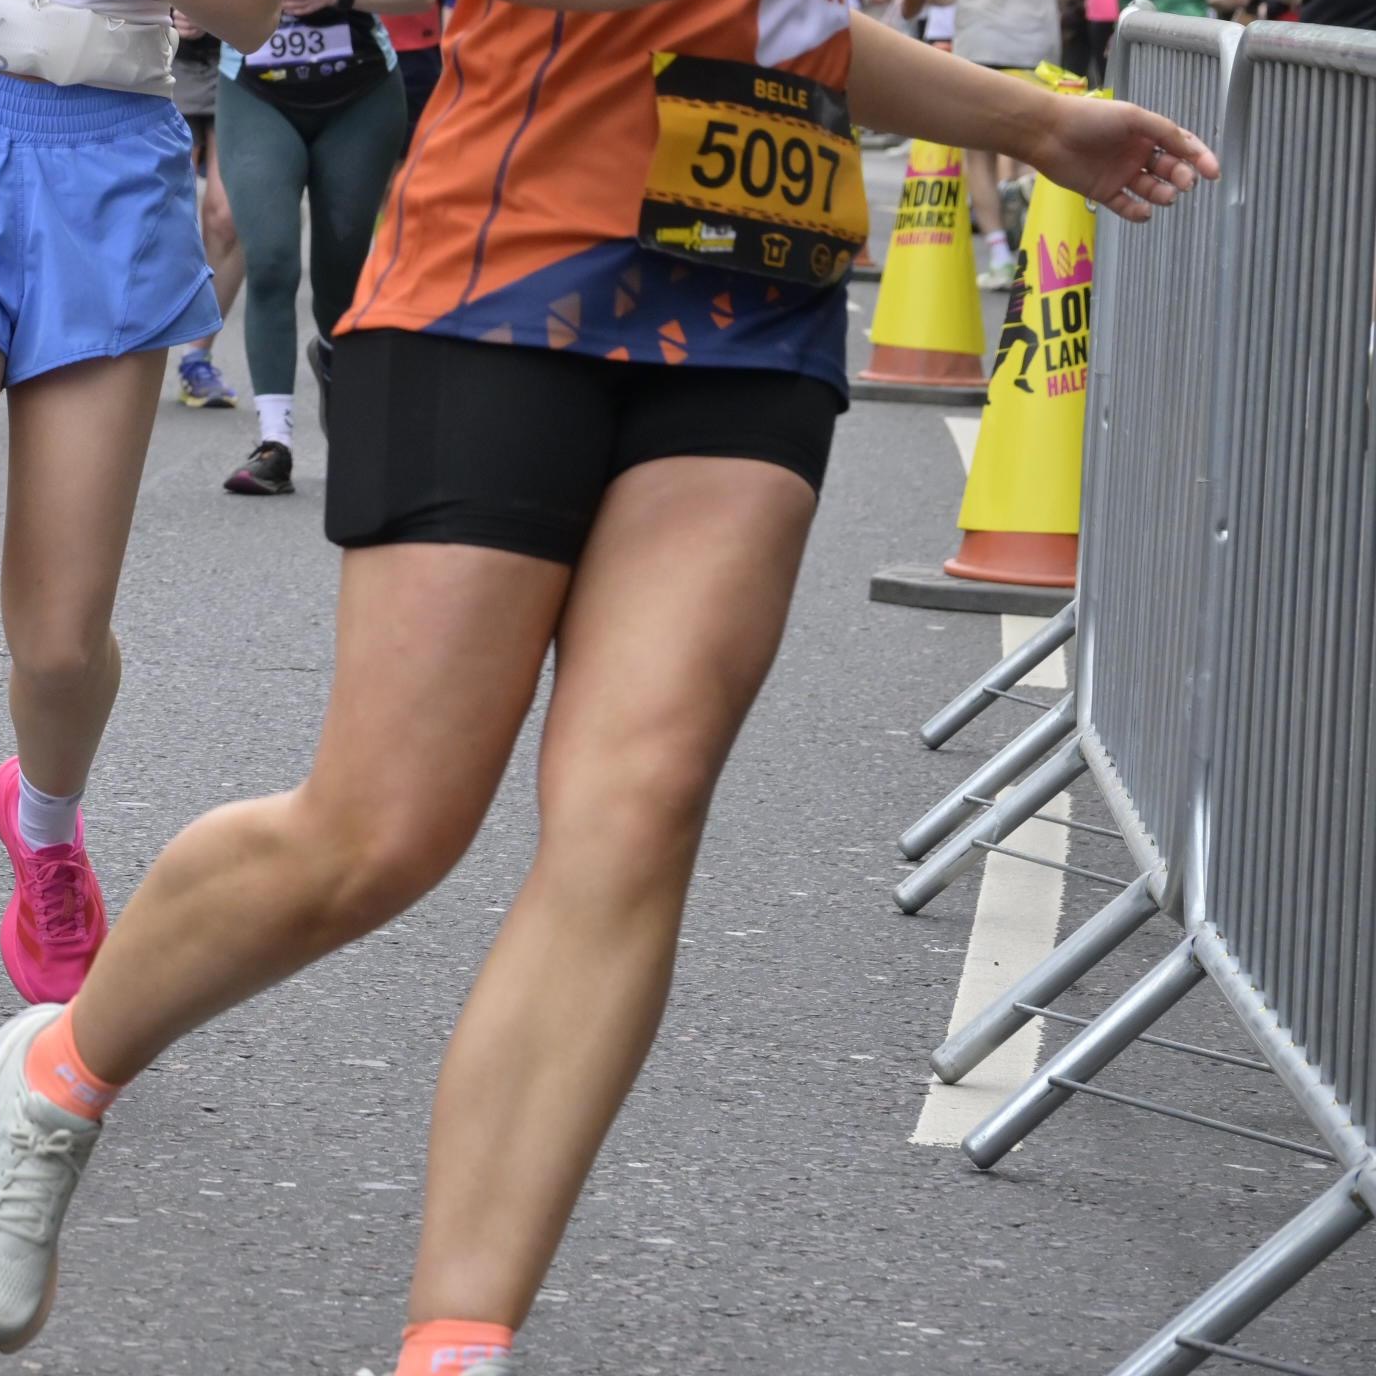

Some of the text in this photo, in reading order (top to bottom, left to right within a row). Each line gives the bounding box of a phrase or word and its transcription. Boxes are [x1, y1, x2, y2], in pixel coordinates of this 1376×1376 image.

[270, 30, 325, 58] 993
[754, 78, 808, 110] BELLE
[691, 120, 841, 214] 5097
[899, 180, 960, 208] NDON
